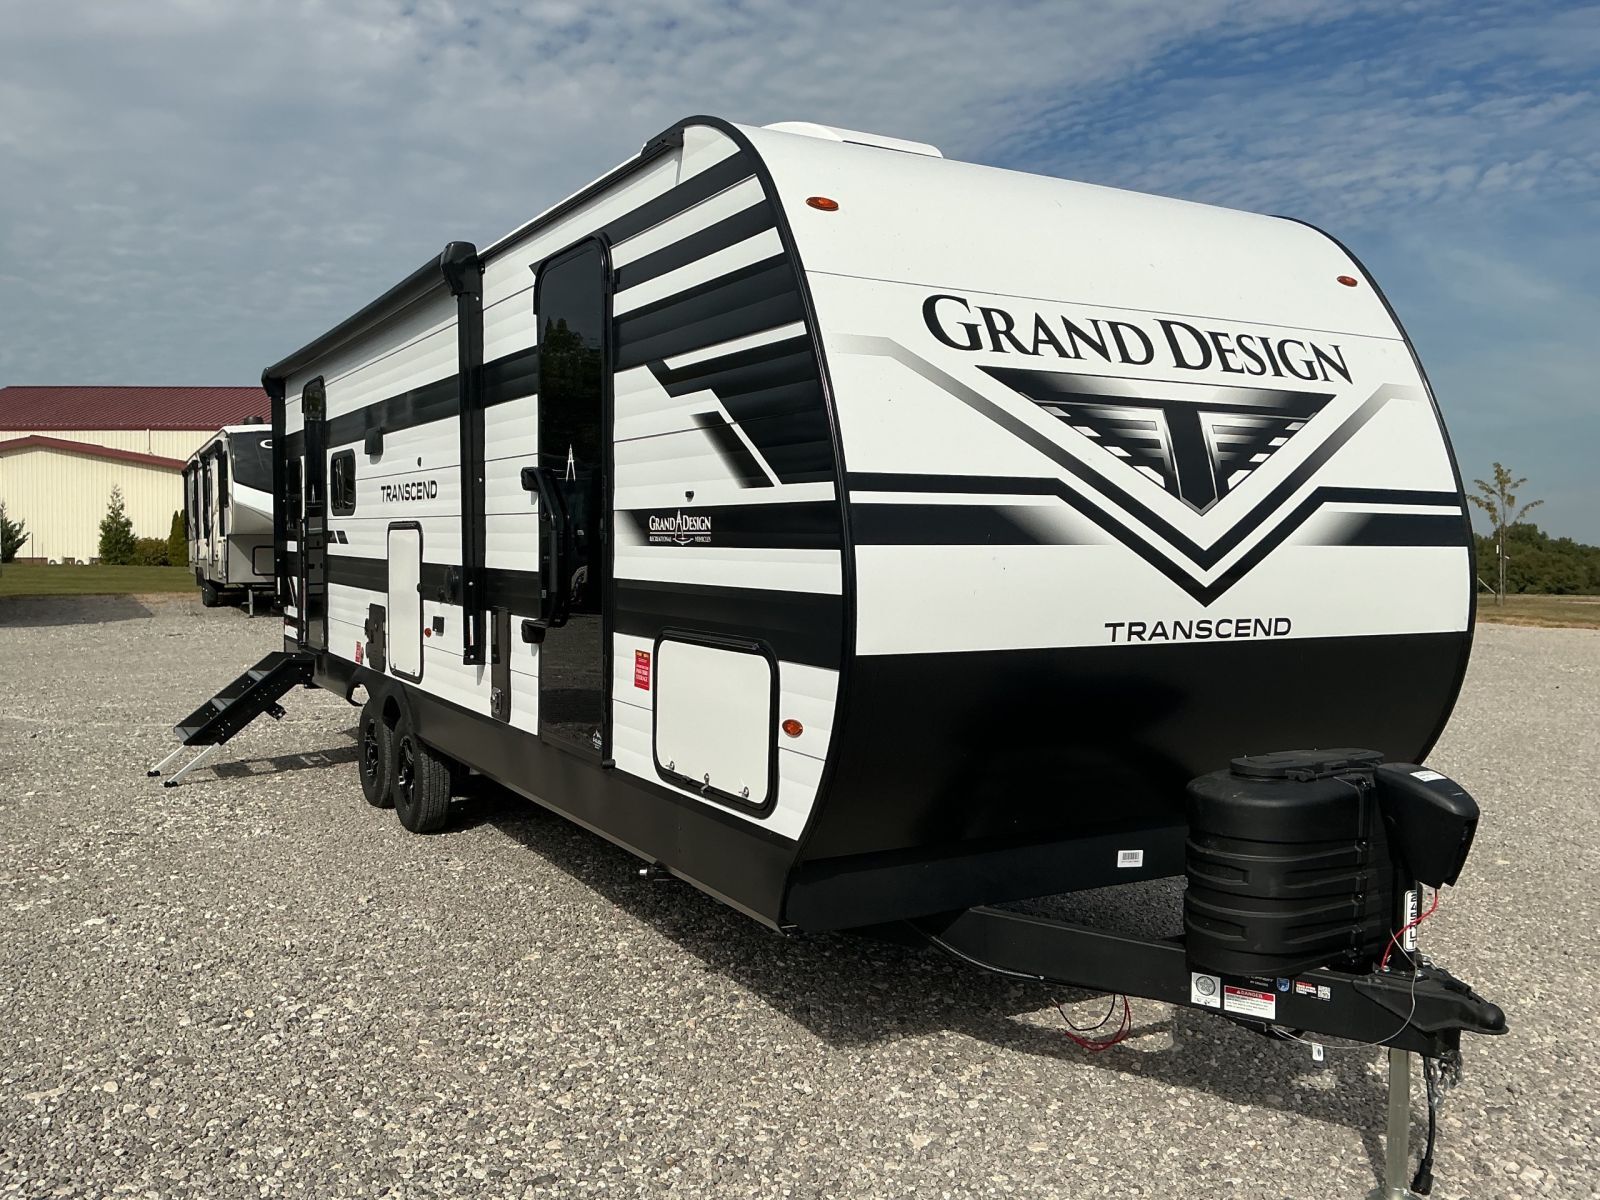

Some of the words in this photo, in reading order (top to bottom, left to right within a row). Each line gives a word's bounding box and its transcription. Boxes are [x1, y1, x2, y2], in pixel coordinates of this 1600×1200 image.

[922, 294, 1154, 366] GRAND
[1154, 318, 1353, 385] DESIGN
[380, 480, 438, 503] TRANSCEND
[649, 515, 676, 531] GRAND
[682, 514, 712, 531] DESIGN
[1105, 617, 1292, 643] TRANSCEND
[1240, 990, 1264, 999] DANGER
